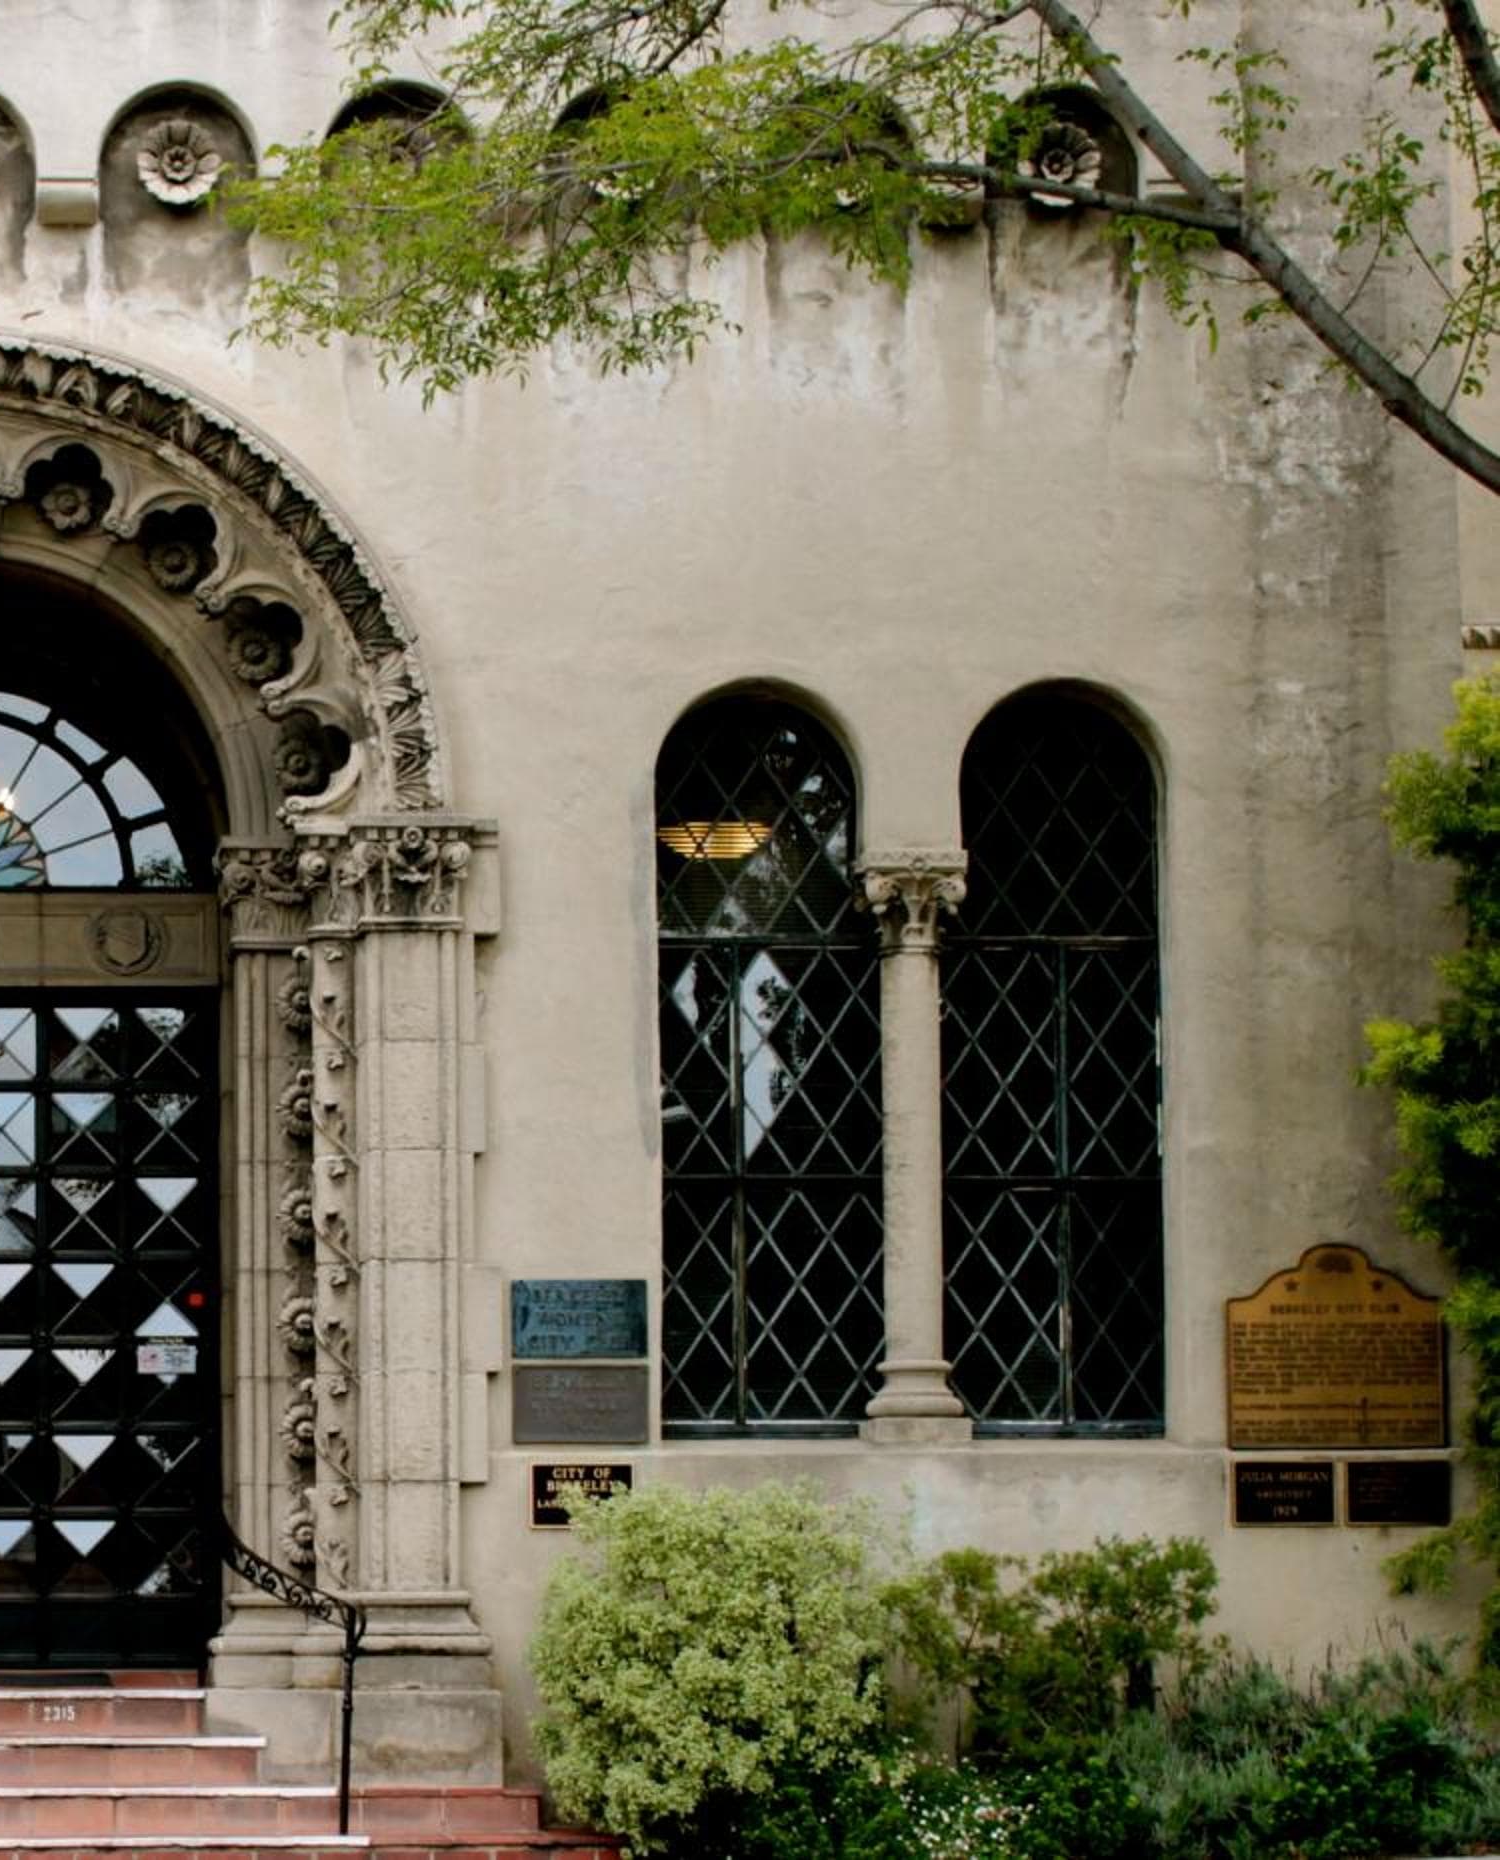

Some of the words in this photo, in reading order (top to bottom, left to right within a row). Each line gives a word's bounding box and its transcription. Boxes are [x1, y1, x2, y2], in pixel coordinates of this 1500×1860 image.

[553, 1467, 585, 1479] CITY
[593, 1467, 612, 1479] OF
[1240, 1471, 1274, 1483] JULIA
[1279, 1471, 1329, 1482] MORGAN
[43, 1705, 75, 1721] 2315
